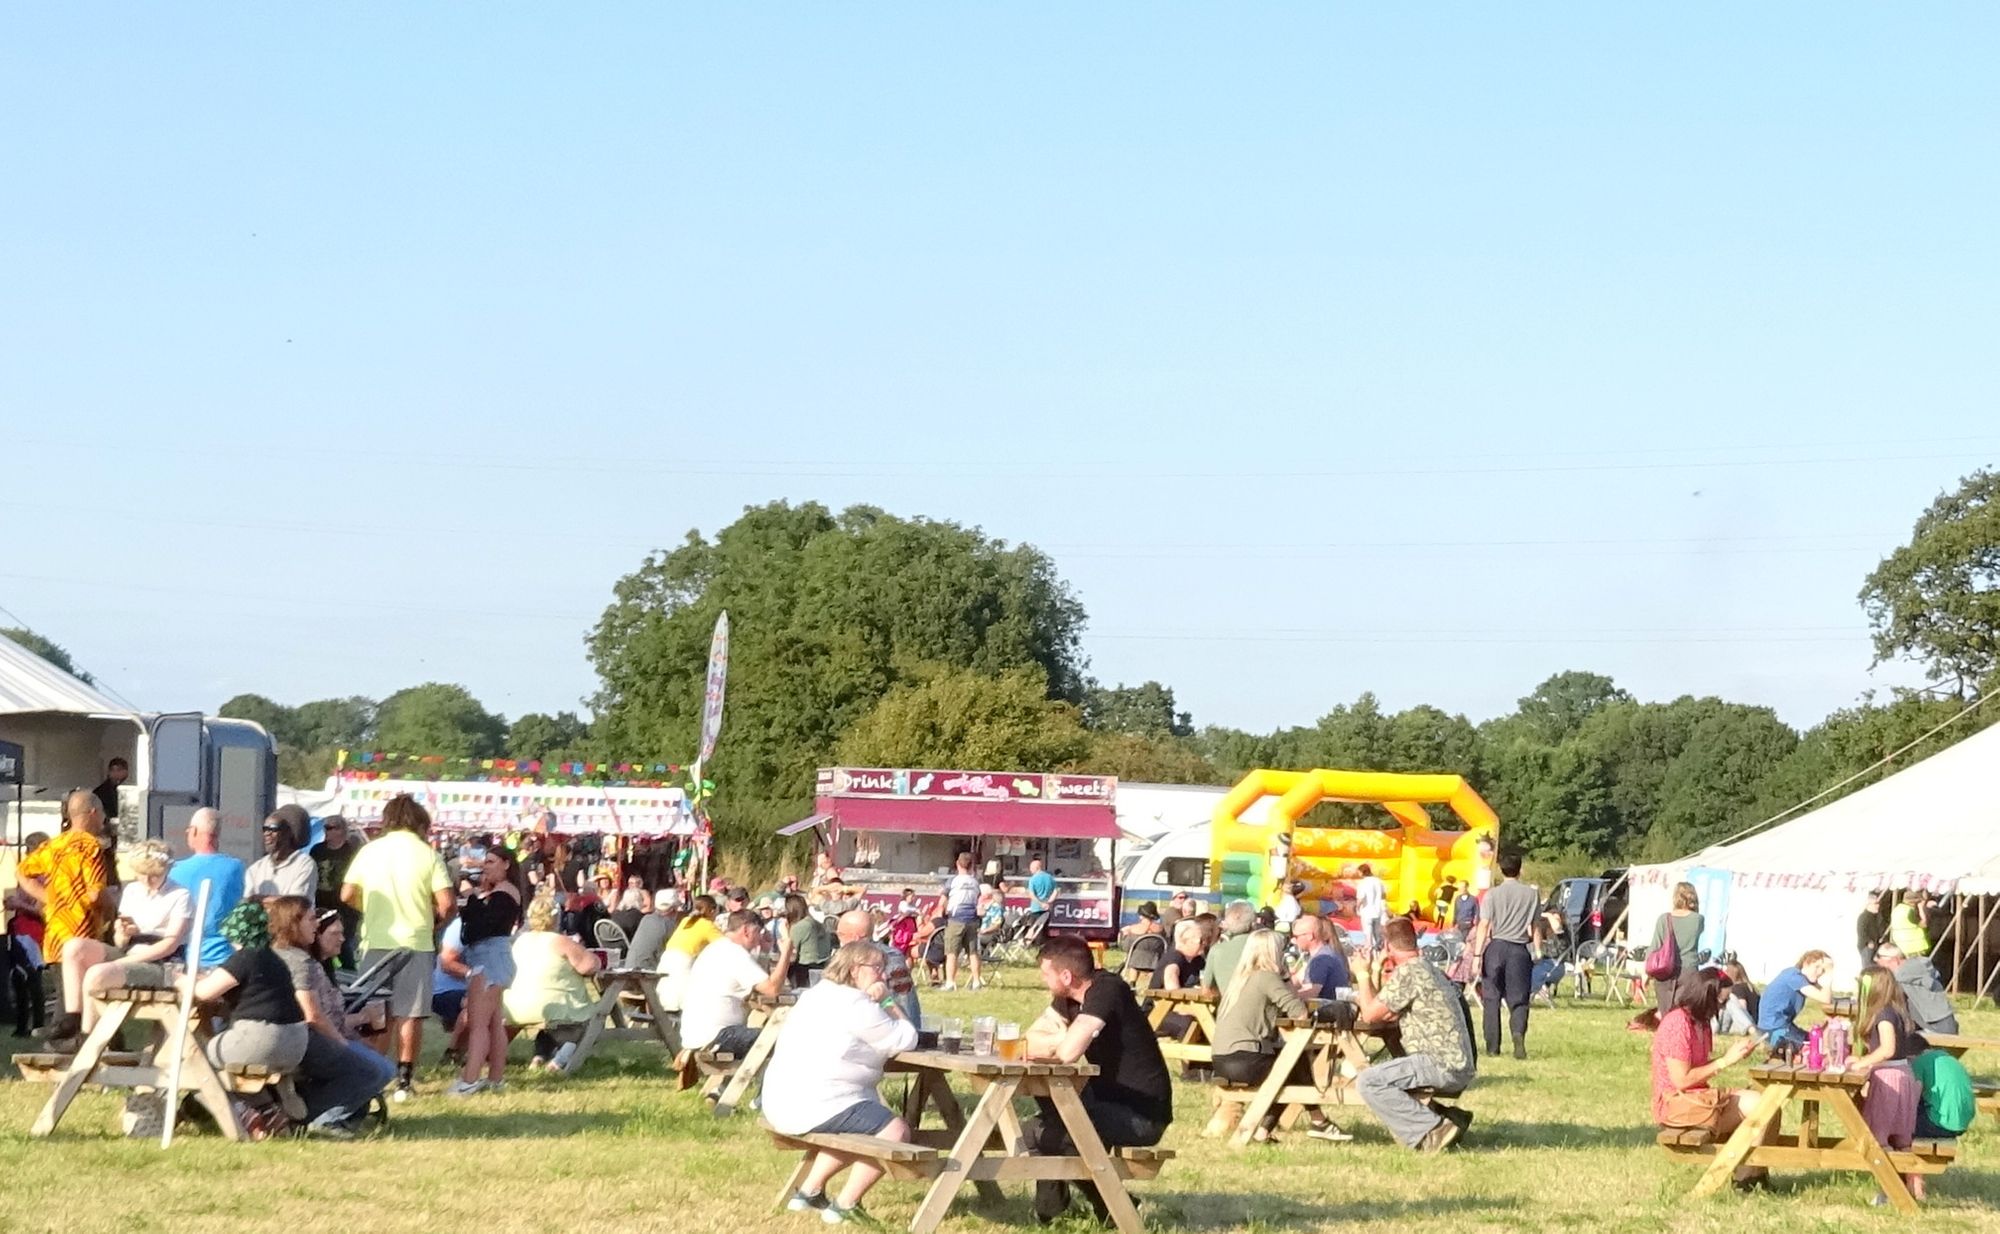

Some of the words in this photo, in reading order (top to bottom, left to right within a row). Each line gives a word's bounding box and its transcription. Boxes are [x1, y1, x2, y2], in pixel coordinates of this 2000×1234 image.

[841, 773, 899, 790] Drinks
[1054, 780, 1109, 796] Sweets
[1054, 903, 1100, 920] Floss
